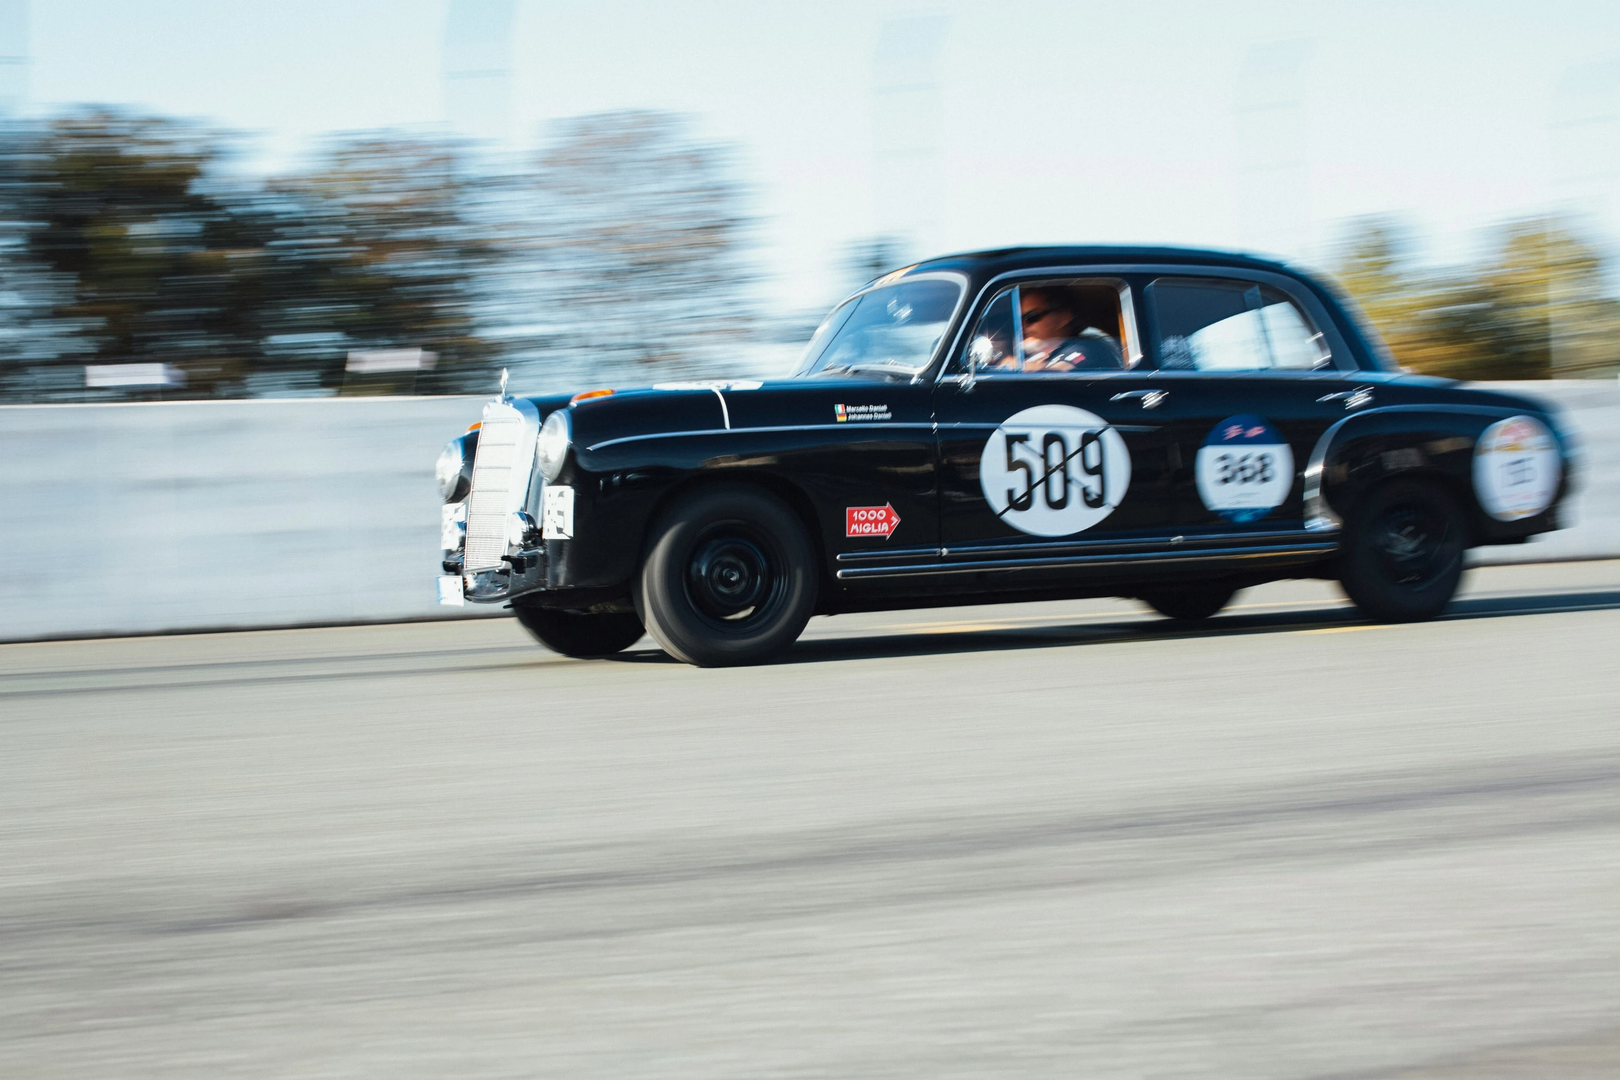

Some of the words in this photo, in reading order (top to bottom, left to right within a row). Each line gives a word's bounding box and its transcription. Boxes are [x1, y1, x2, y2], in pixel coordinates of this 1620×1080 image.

[1005, 432, 1105, 511] 509
[853, 509, 887, 521] 1000
[850, 522, 889, 534] MIGLIA
